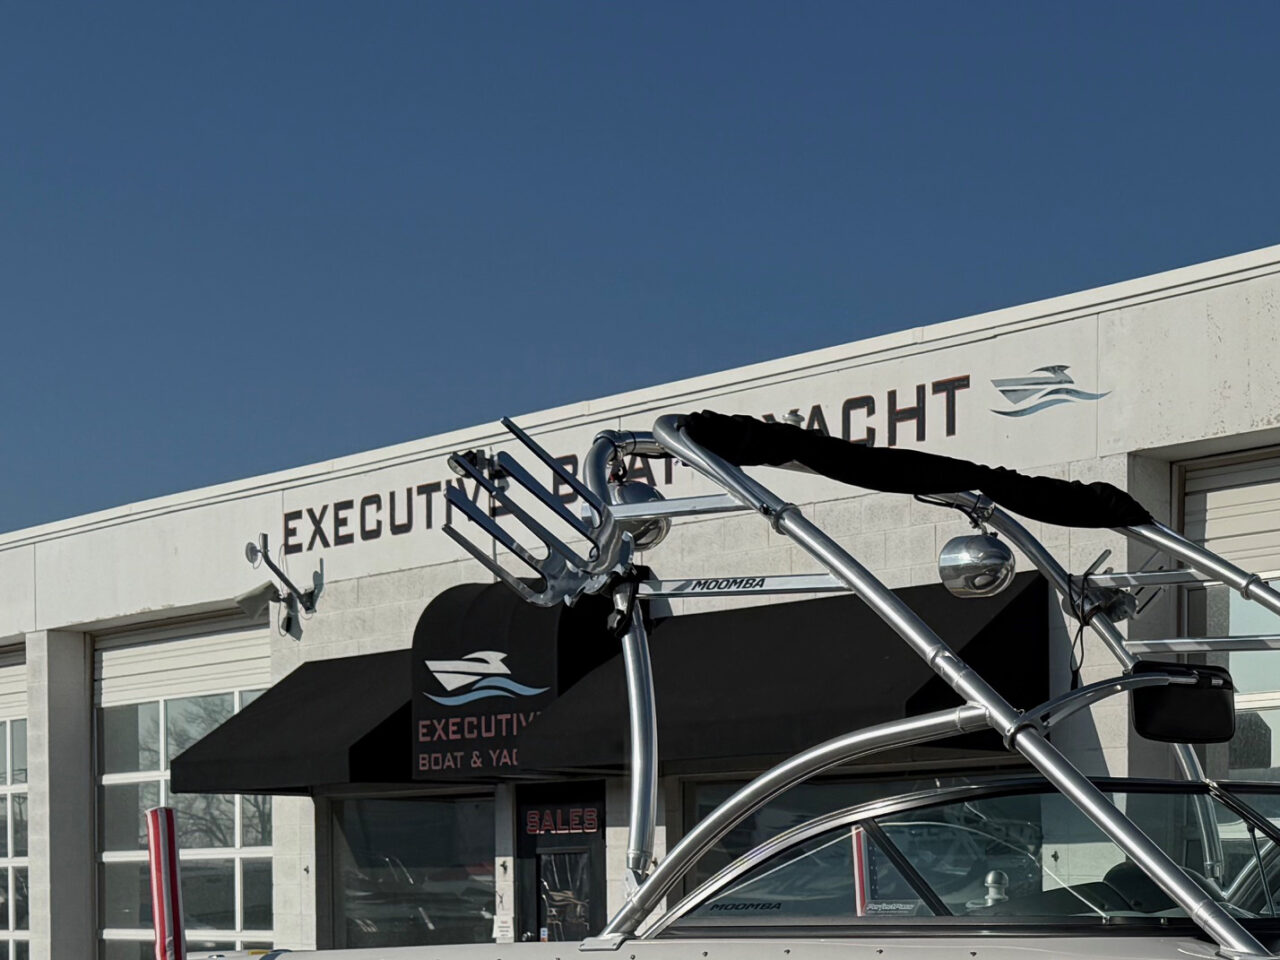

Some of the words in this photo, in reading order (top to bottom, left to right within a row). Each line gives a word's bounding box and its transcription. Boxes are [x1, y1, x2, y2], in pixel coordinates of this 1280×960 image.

[284, 468, 513, 555] EXECUTIV
[762, 374, 970, 447] ACHT
[691, 577, 766, 591] MOOMBA
[418, 751, 464, 771] BOAT
[470, 751, 482, 768] &
[526, 807, 598, 834] SALES
[710, 901, 783, 912] MOOMBA
